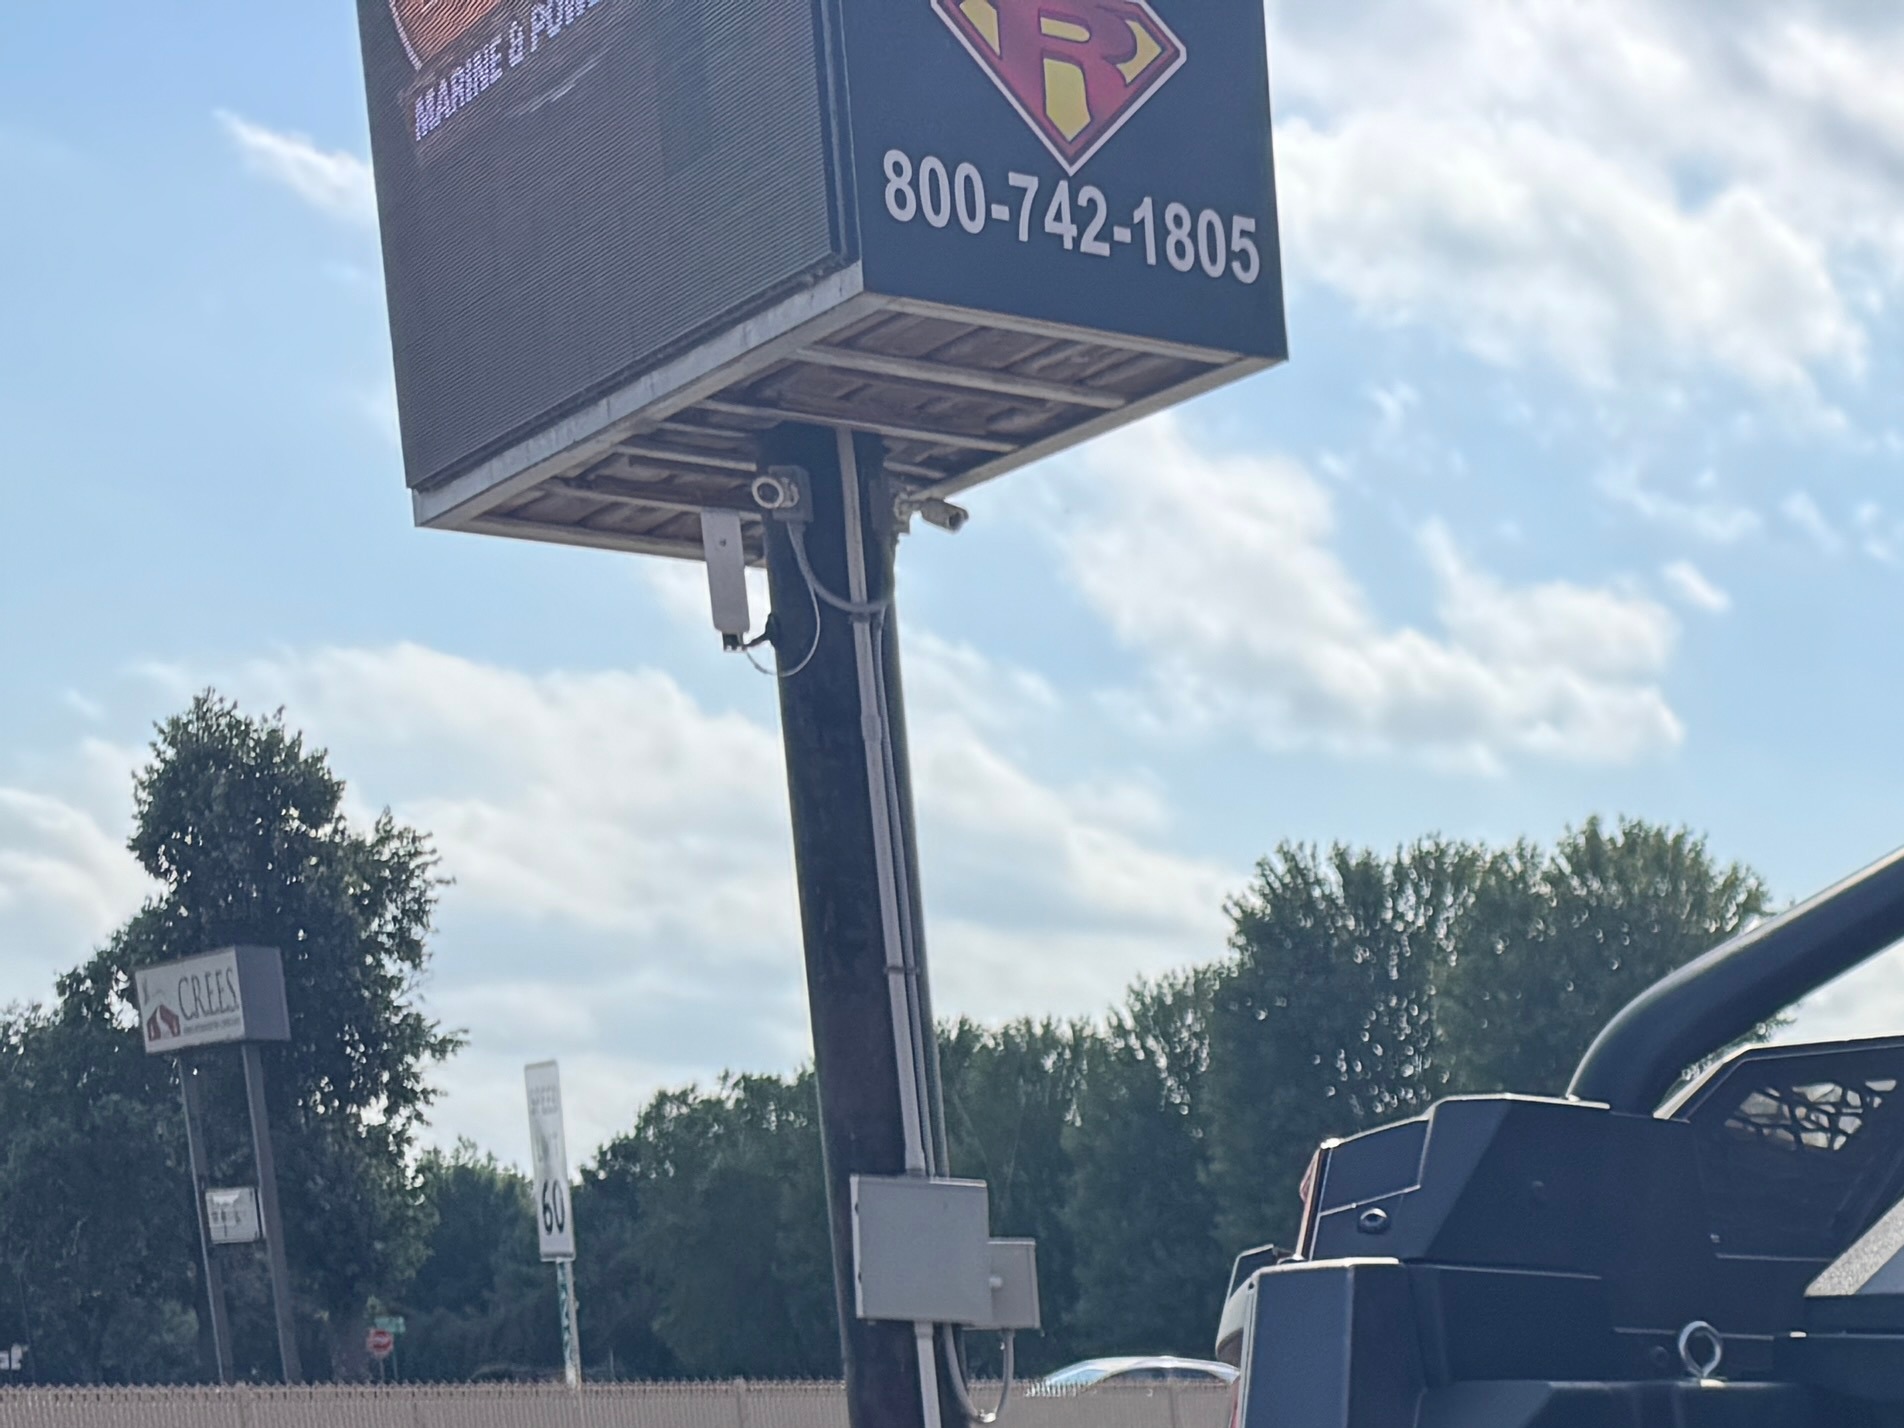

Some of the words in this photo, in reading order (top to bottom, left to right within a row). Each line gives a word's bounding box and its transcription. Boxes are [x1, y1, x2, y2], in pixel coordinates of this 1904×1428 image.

[414, 34, 503, 141] MARINE
[508, 20, 525, 68] &
[883, 149, 1261, 284] 800-742-1805
[177, 966, 240, 1021] CREES
[542, 1178, 565, 1236] 60
